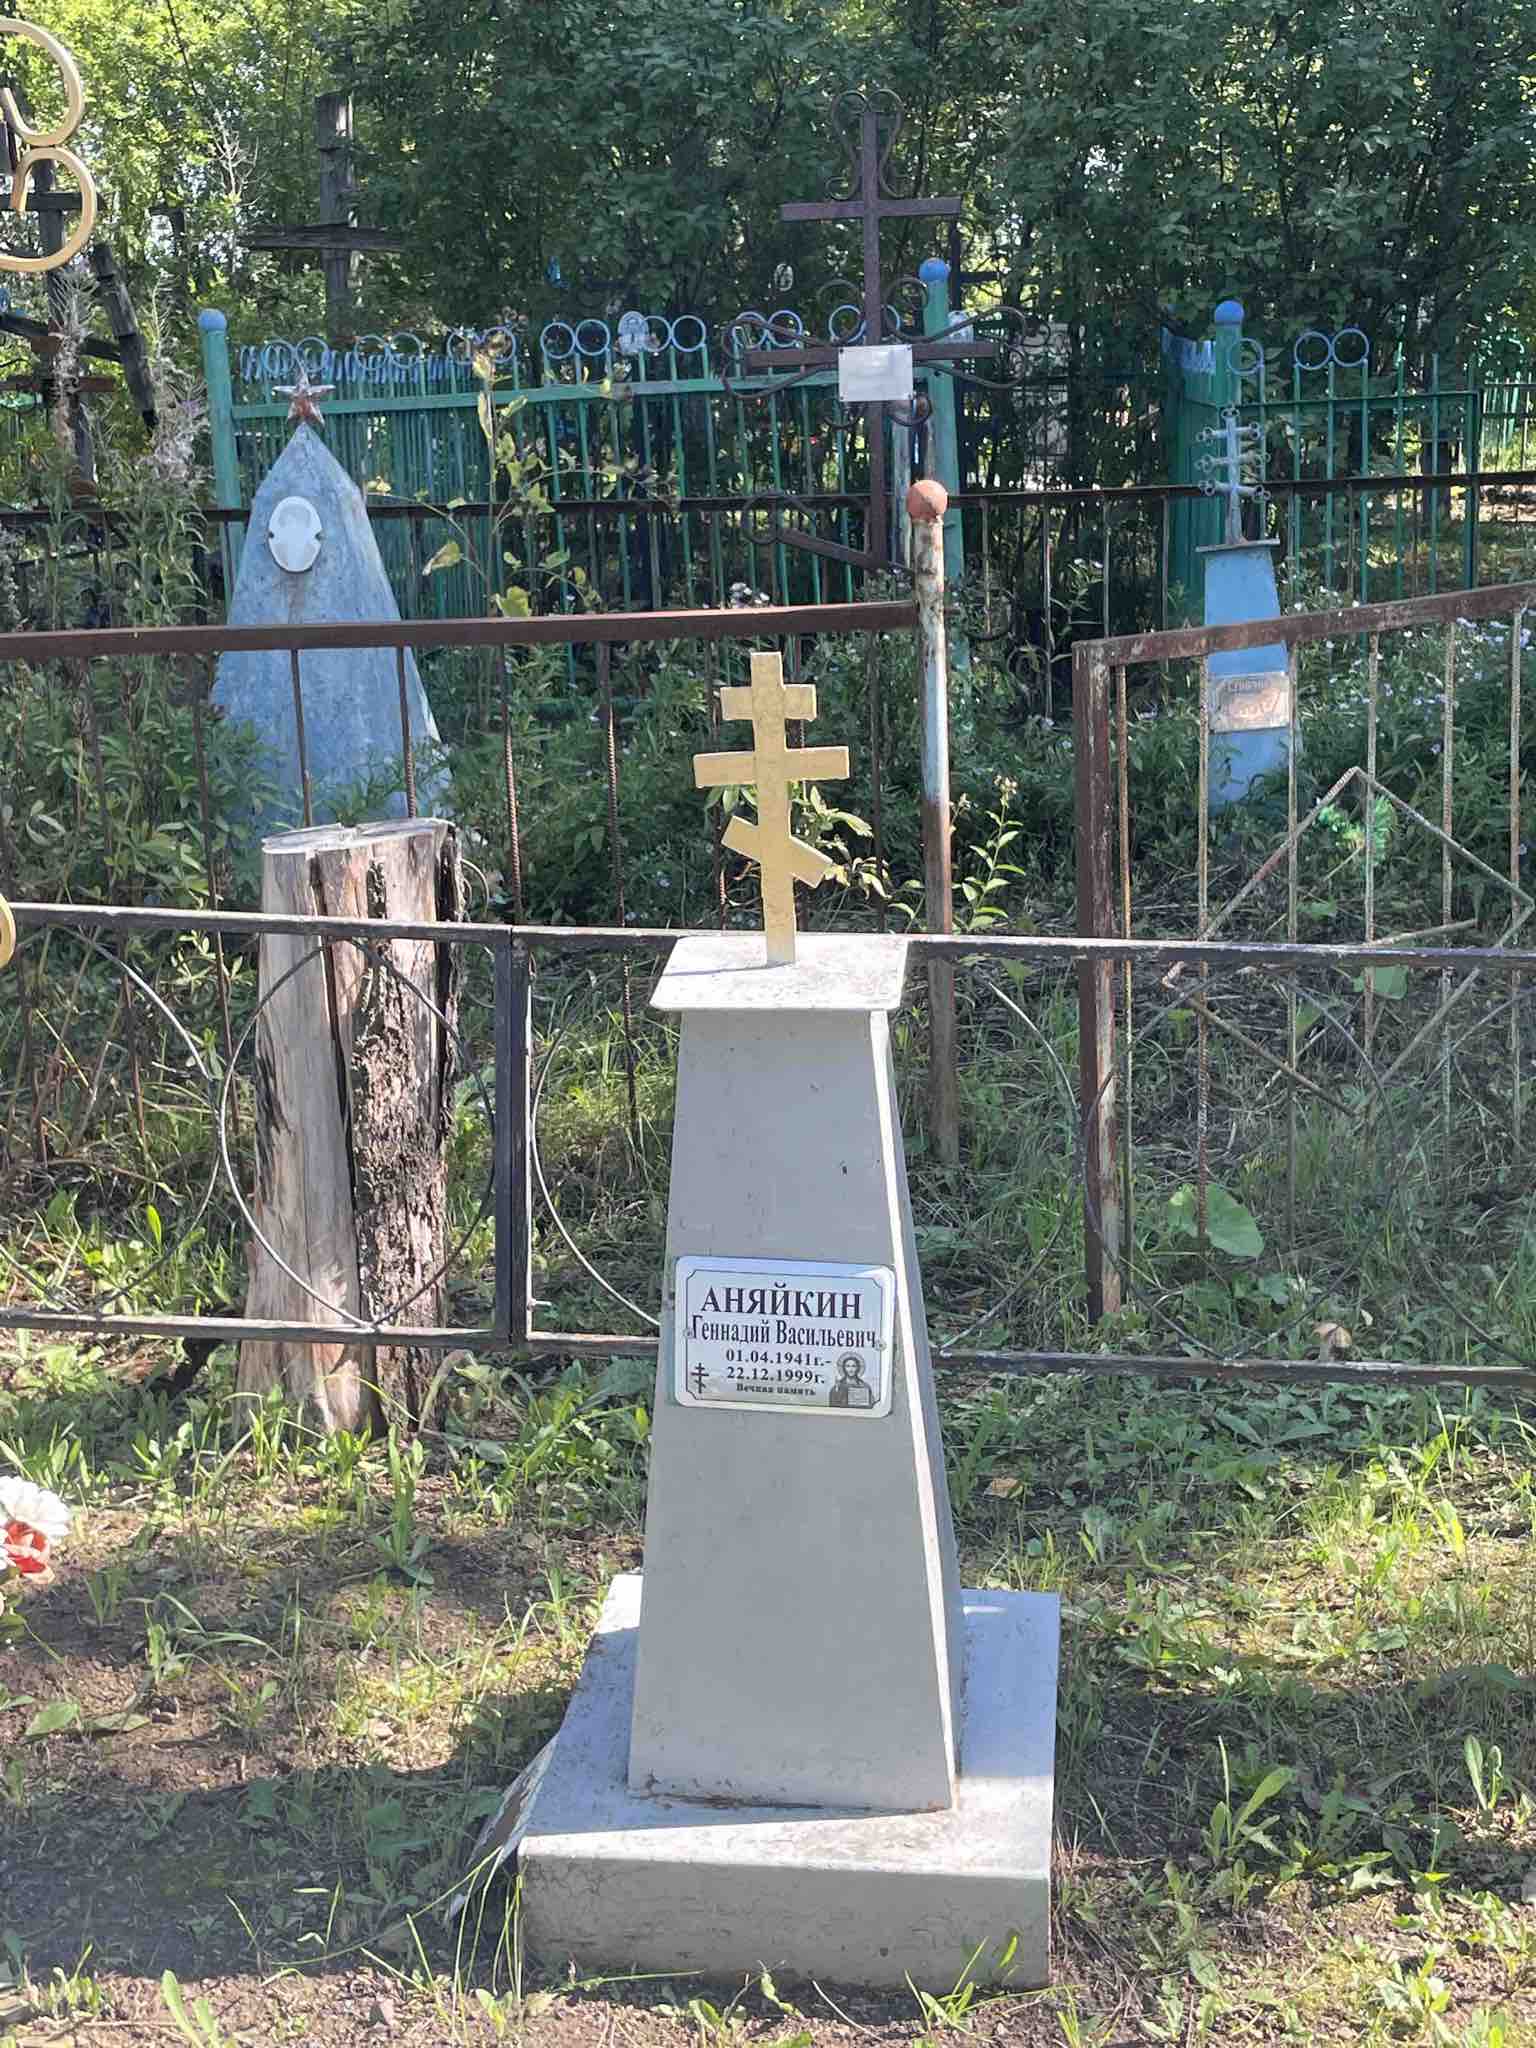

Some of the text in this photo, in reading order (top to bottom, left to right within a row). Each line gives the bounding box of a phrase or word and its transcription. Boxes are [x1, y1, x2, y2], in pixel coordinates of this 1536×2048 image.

[700, 1281, 863, 1320] АНЯЙКИН
[691, 1315, 877, 1349] Геннадий Васильевич
[726, 1366, 825, 1384] 22.12.1999г.
